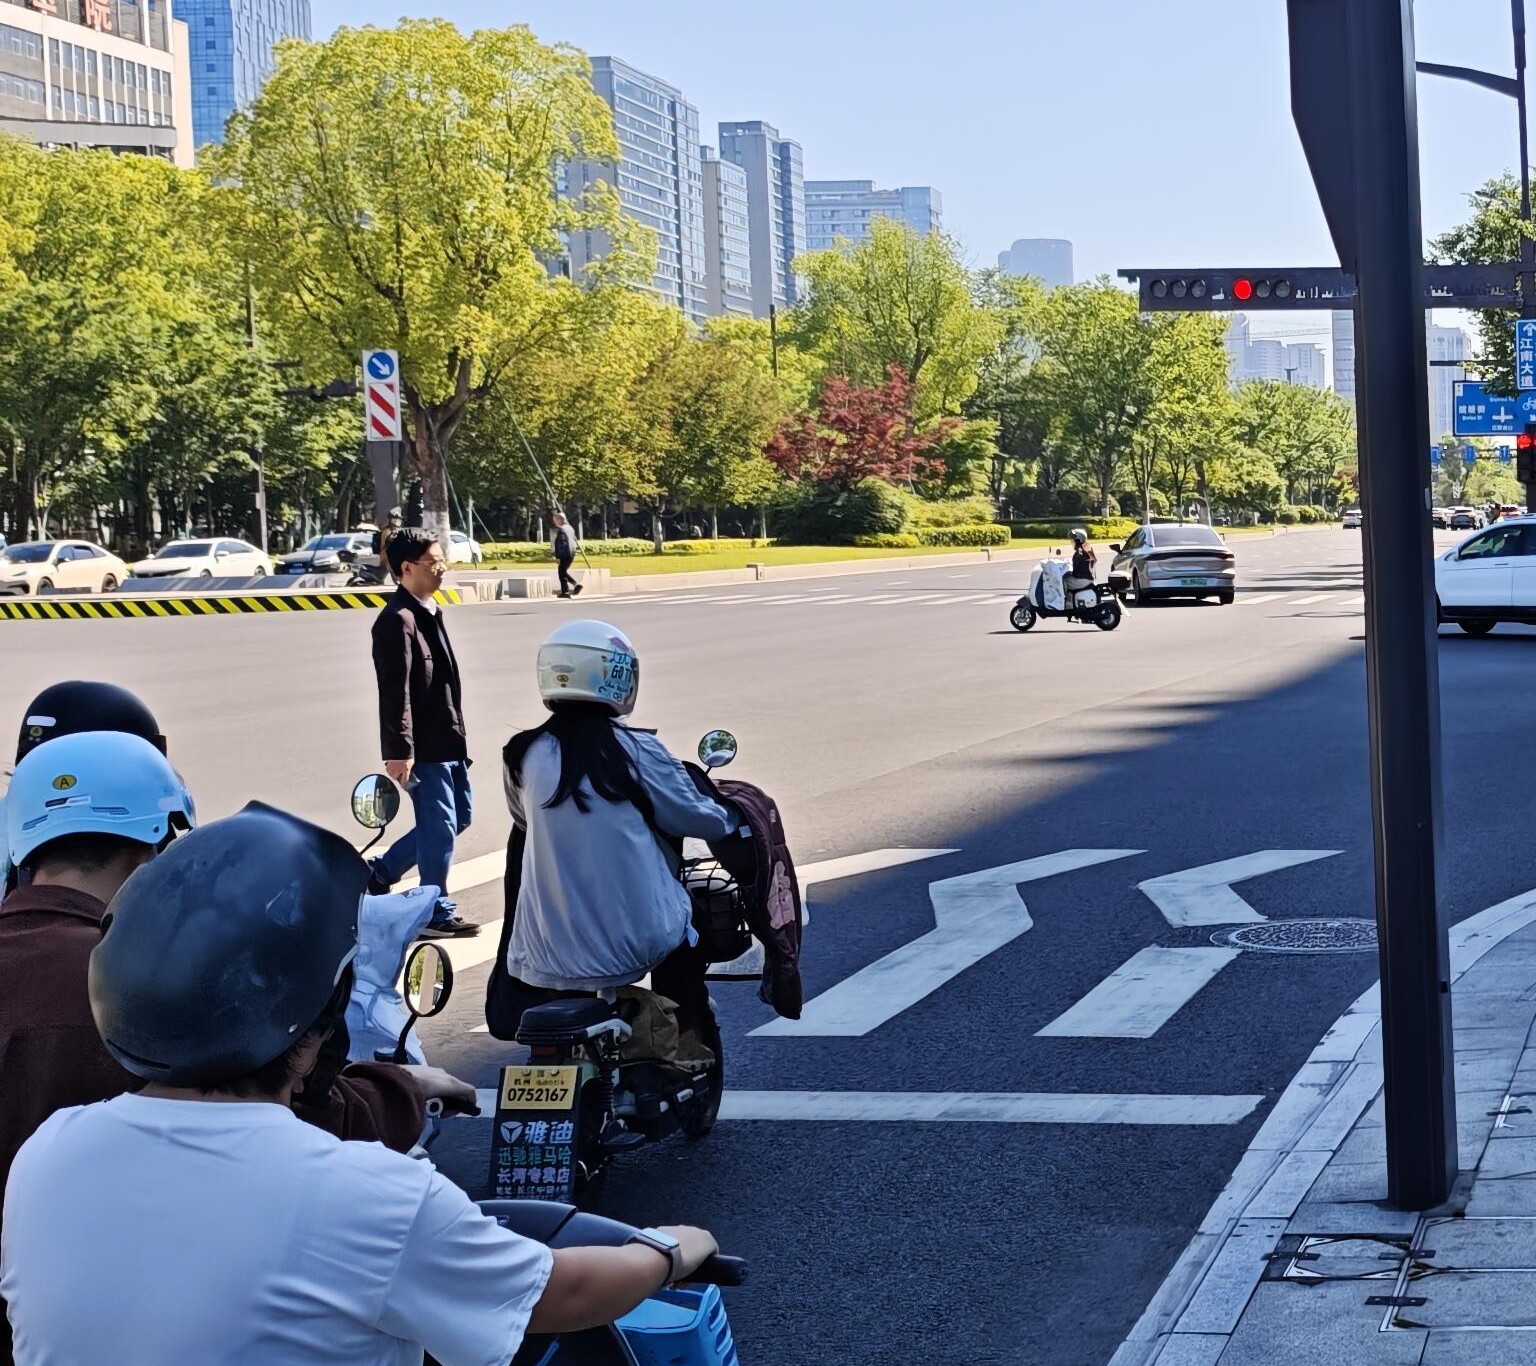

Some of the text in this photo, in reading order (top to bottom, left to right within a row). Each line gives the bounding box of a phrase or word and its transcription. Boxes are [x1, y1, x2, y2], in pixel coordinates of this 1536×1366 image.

[60, 777, 70, 787] A
[507, 1088, 568, 1102] 0752167
[524, 1120, 574, 1144] 雅迪
